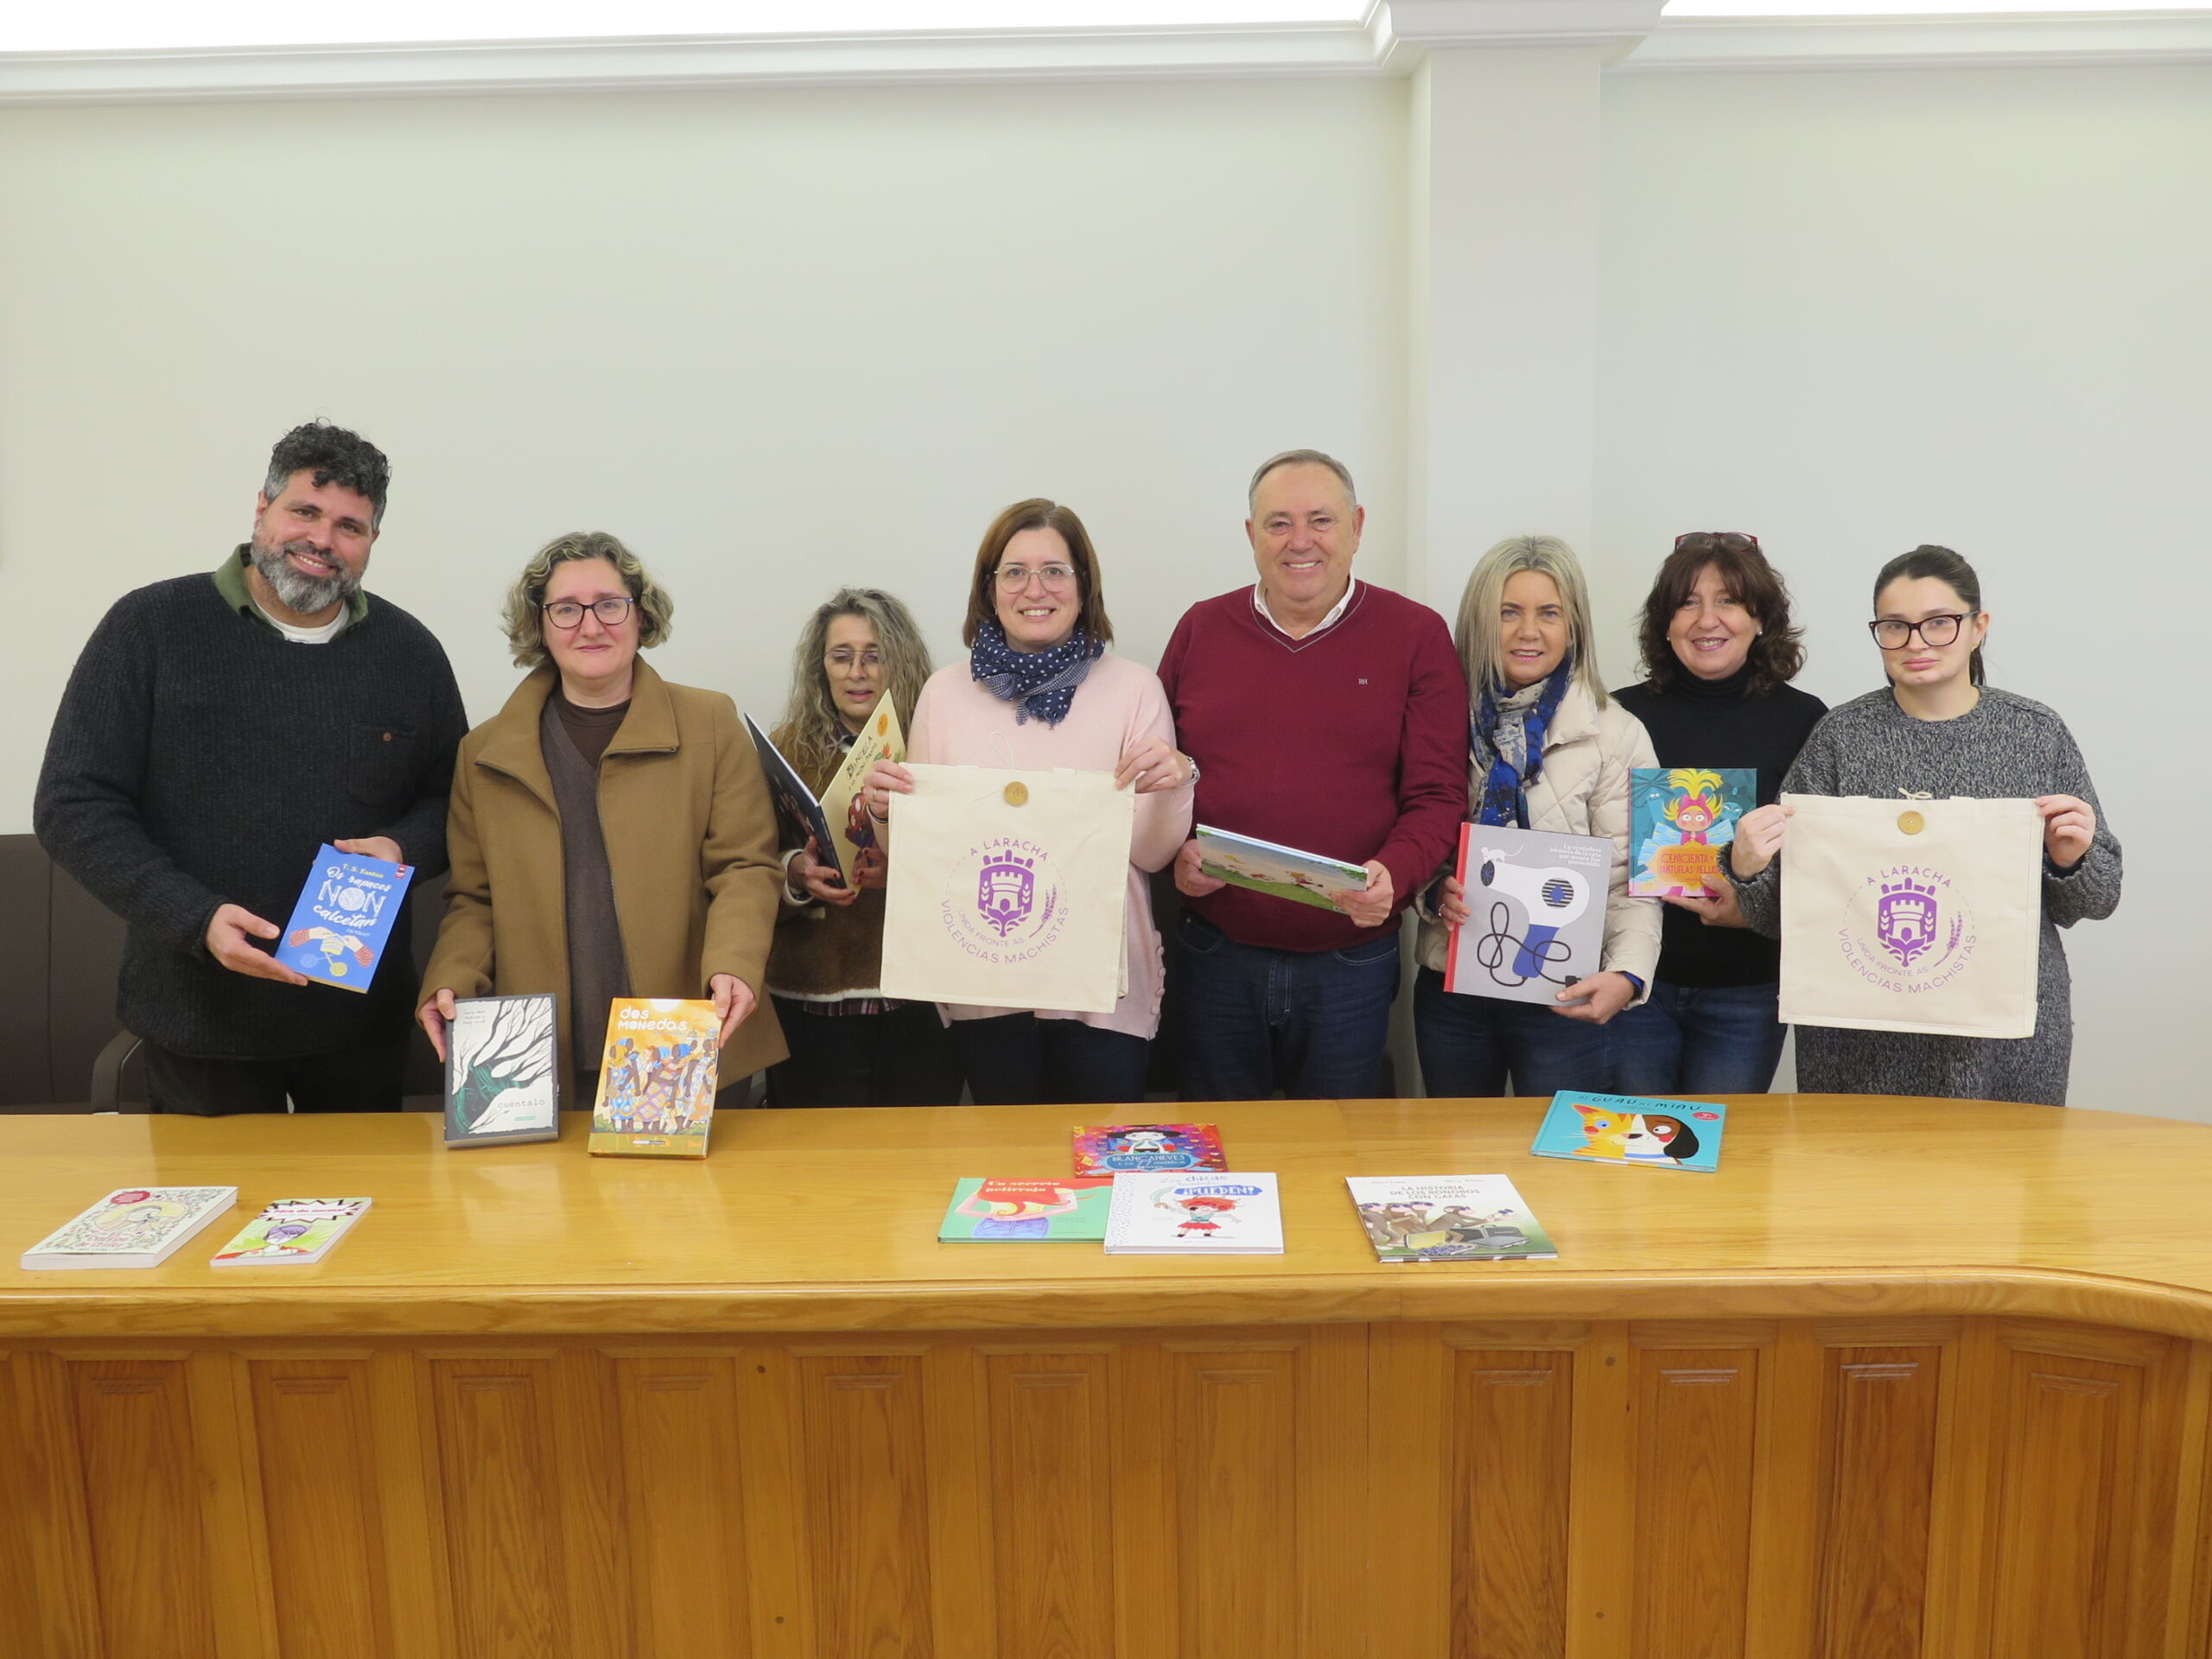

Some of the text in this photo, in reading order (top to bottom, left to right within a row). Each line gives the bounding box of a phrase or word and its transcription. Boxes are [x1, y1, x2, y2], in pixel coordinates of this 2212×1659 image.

[969, 837, 1049, 861] A LARACHA
[1661, 853, 1708, 863] CENICIENTA
[327, 867, 393, 893] Os rapaces
[1867, 865, 1951, 888] A LARACHA
[318, 880, 387, 918] NON
[313, 905, 378, 929] calcetan
[941, 899, 1069, 963] VIOLENCIAS MACHISTAS
[975, 931, 1010, 947] FRONTE
[1013, 937, 1025, 945] AS
[1839, 928, 1976, 993] VIOLENCIAS MACHISTAS
[1876, 961, 1914, 977] FRONTE
[1916, 966, 1929, 975] AS
[497, 1098, 546, 1109] cuéntalo
[1592, 1096, 1637, 1104] GUAU
